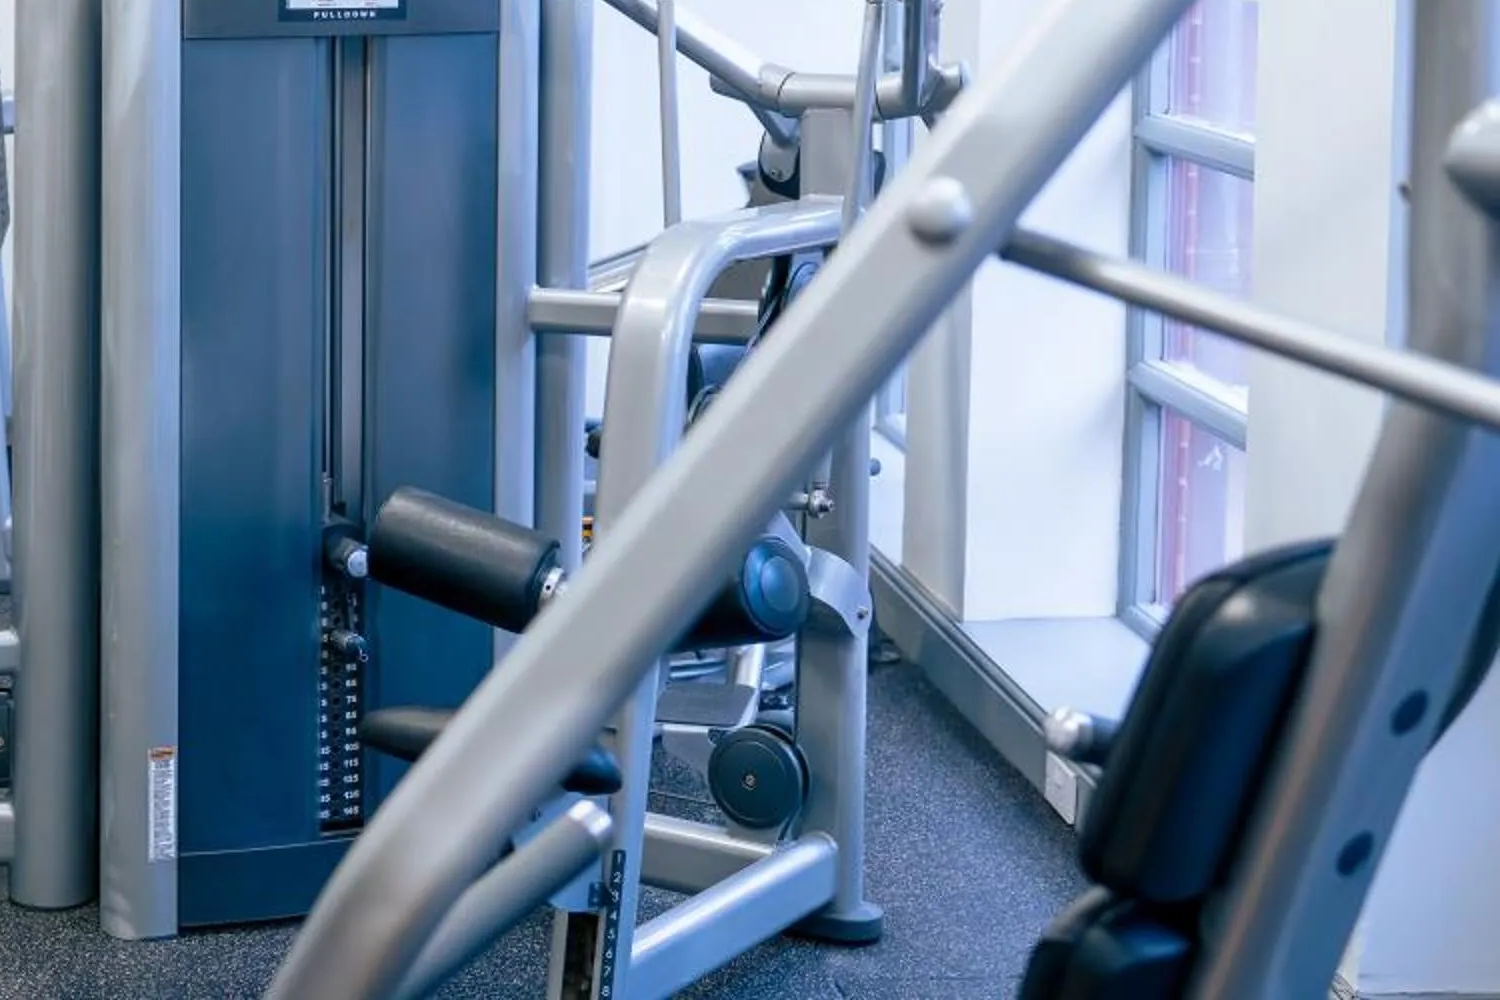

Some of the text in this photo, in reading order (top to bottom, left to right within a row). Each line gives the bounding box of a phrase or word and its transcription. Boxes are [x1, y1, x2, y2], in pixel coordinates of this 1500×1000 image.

[313, 10, 376, 19] PULLDOWN
[613, 872, 621, 882] 2
[610, 910, 617, 920] 4
[607, 929, 615, 939] 5
[605, 949, 613, 958] 6
[604, 966, 612, 977] 7
[601, 986, 611, 997] 8
